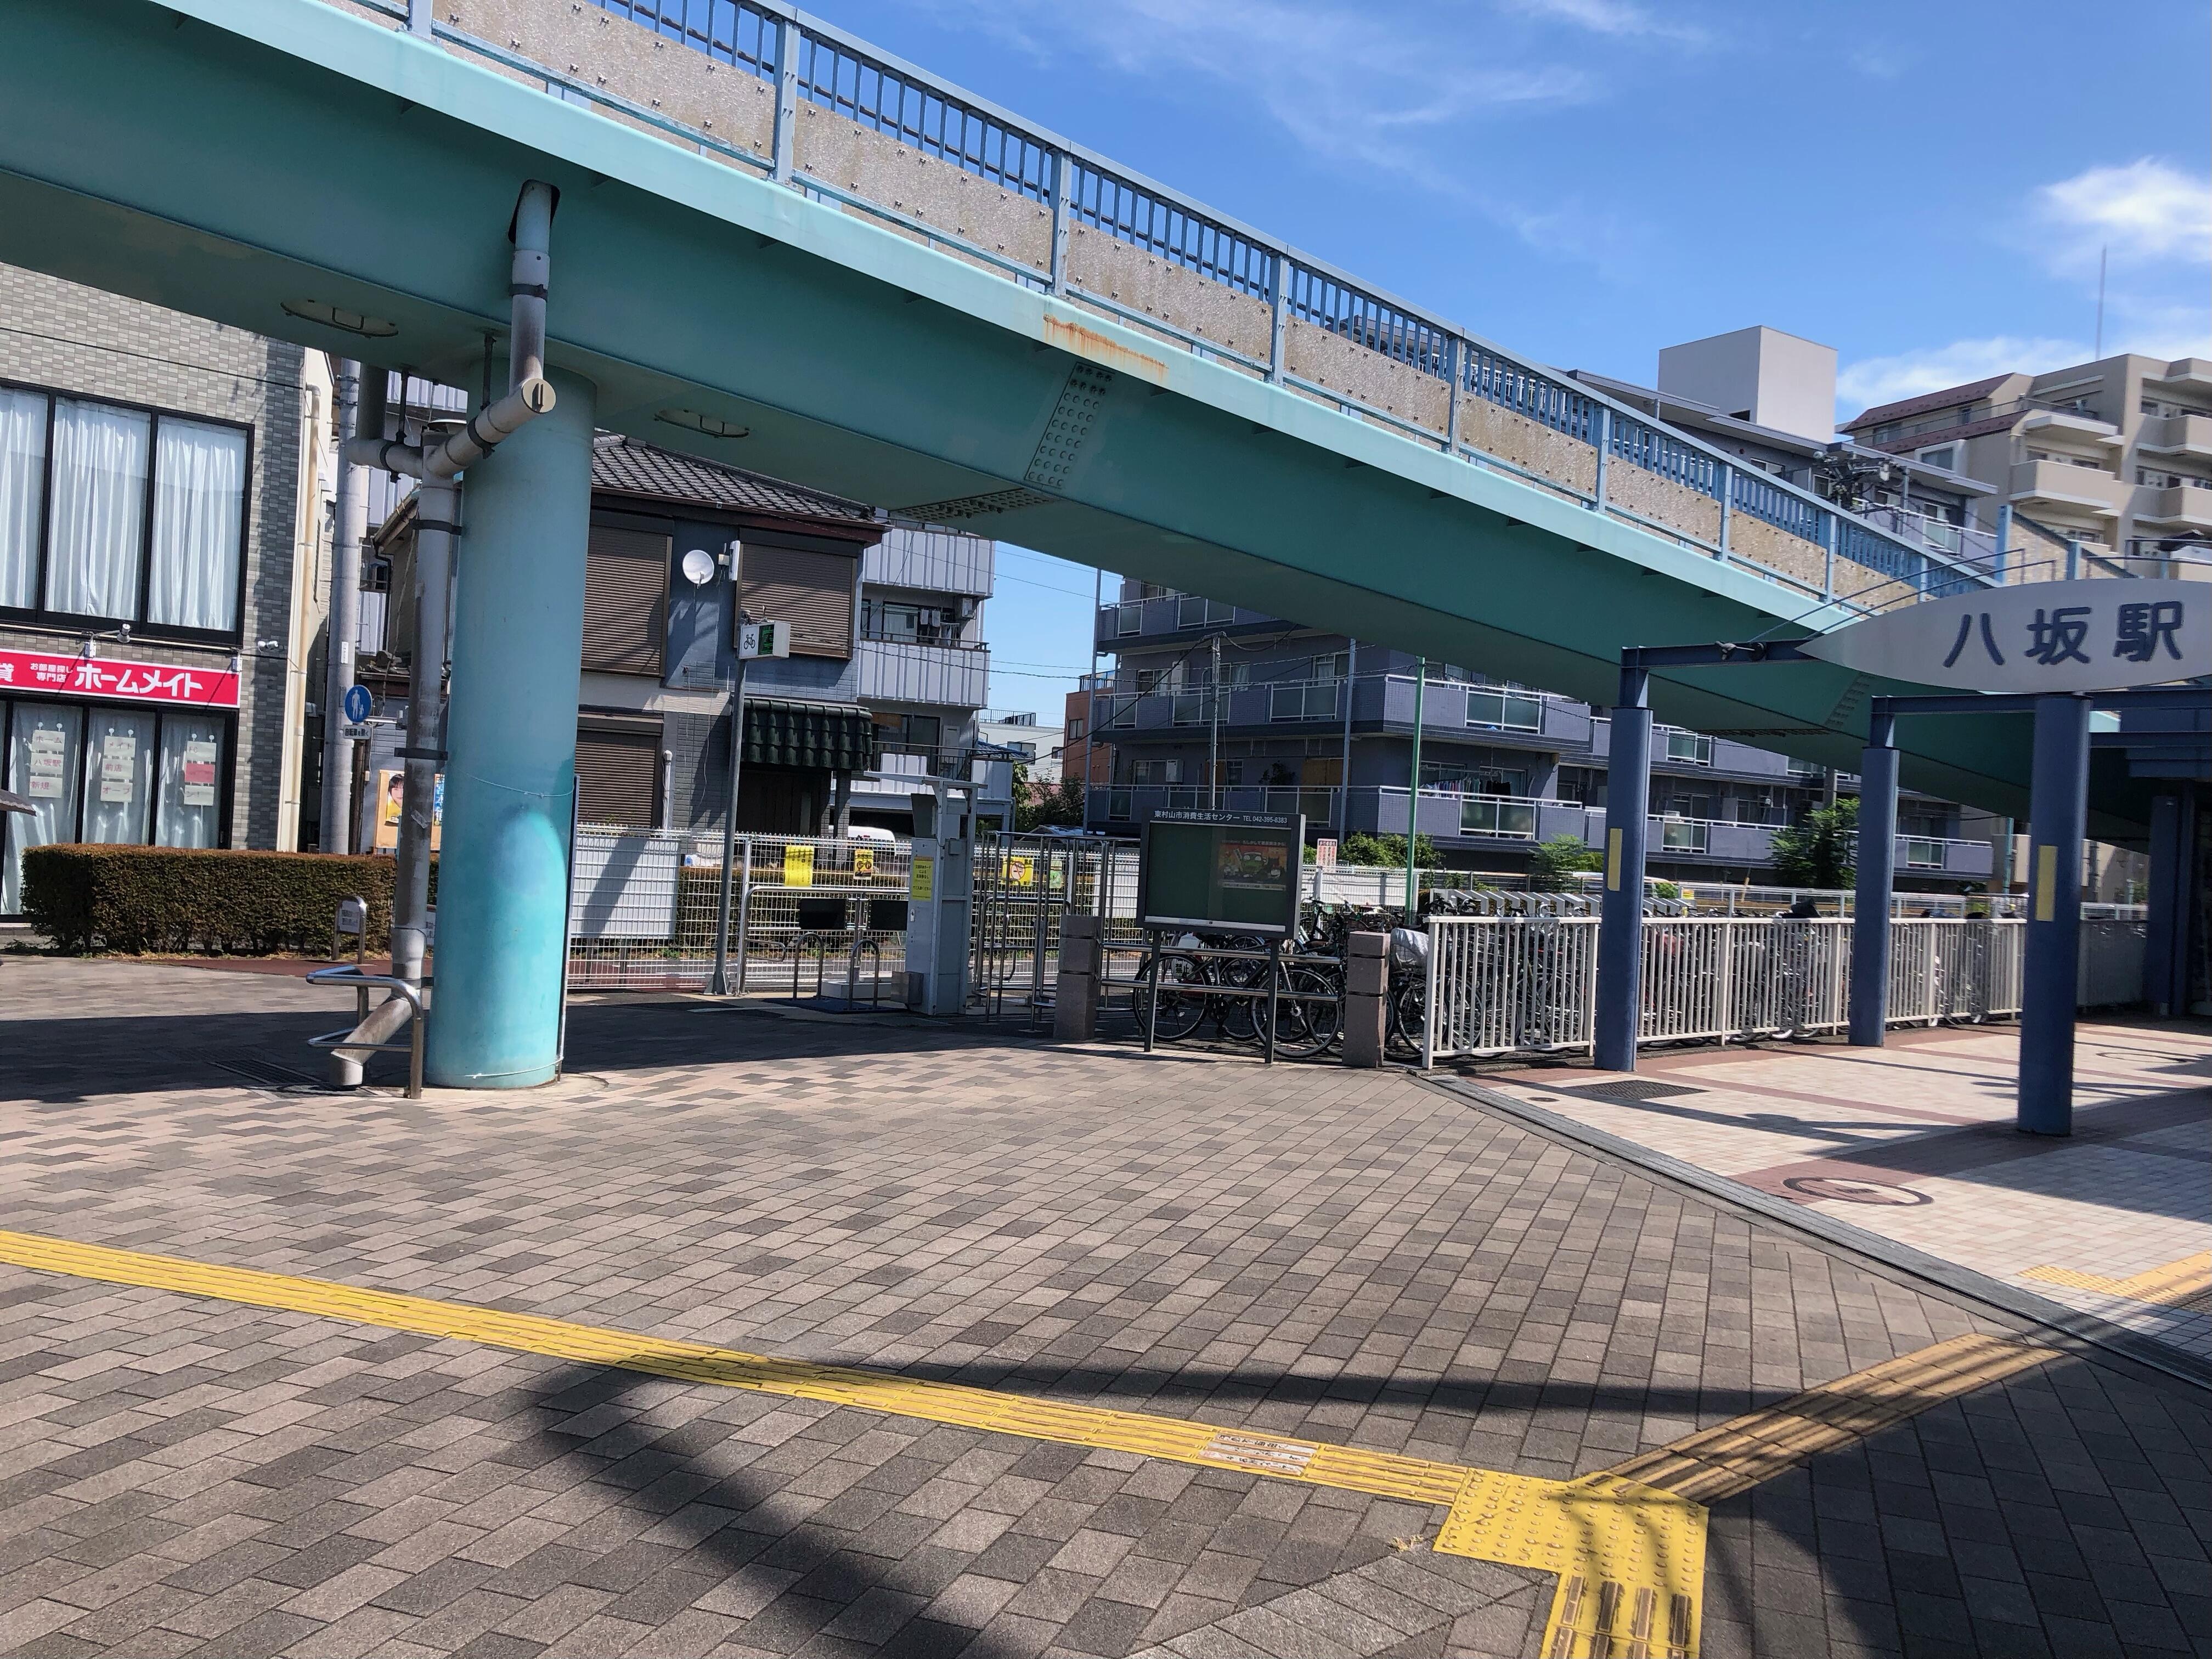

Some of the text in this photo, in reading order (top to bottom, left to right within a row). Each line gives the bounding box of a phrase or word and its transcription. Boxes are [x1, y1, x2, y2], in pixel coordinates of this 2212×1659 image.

[1943, 601, 2185, 668] 八坂駅
[30, 663, 73, 674] お部屋探し
[36, 672, 66, 683] 専門店
[75, 663, 204, 698] ホームメイト
[345, 728, 369, 737] 自転車を除く
[36, 735, 62, 744] ホーム
[33, 759, 62, 767] 八坂駅
[105, 764, 123, 772] 前店
[30, 781, 50, 791] 新規
[1154, 810, 1240, 821] 東村山市消費生活センター
[1175, 963, 1190, 974] 禁止
